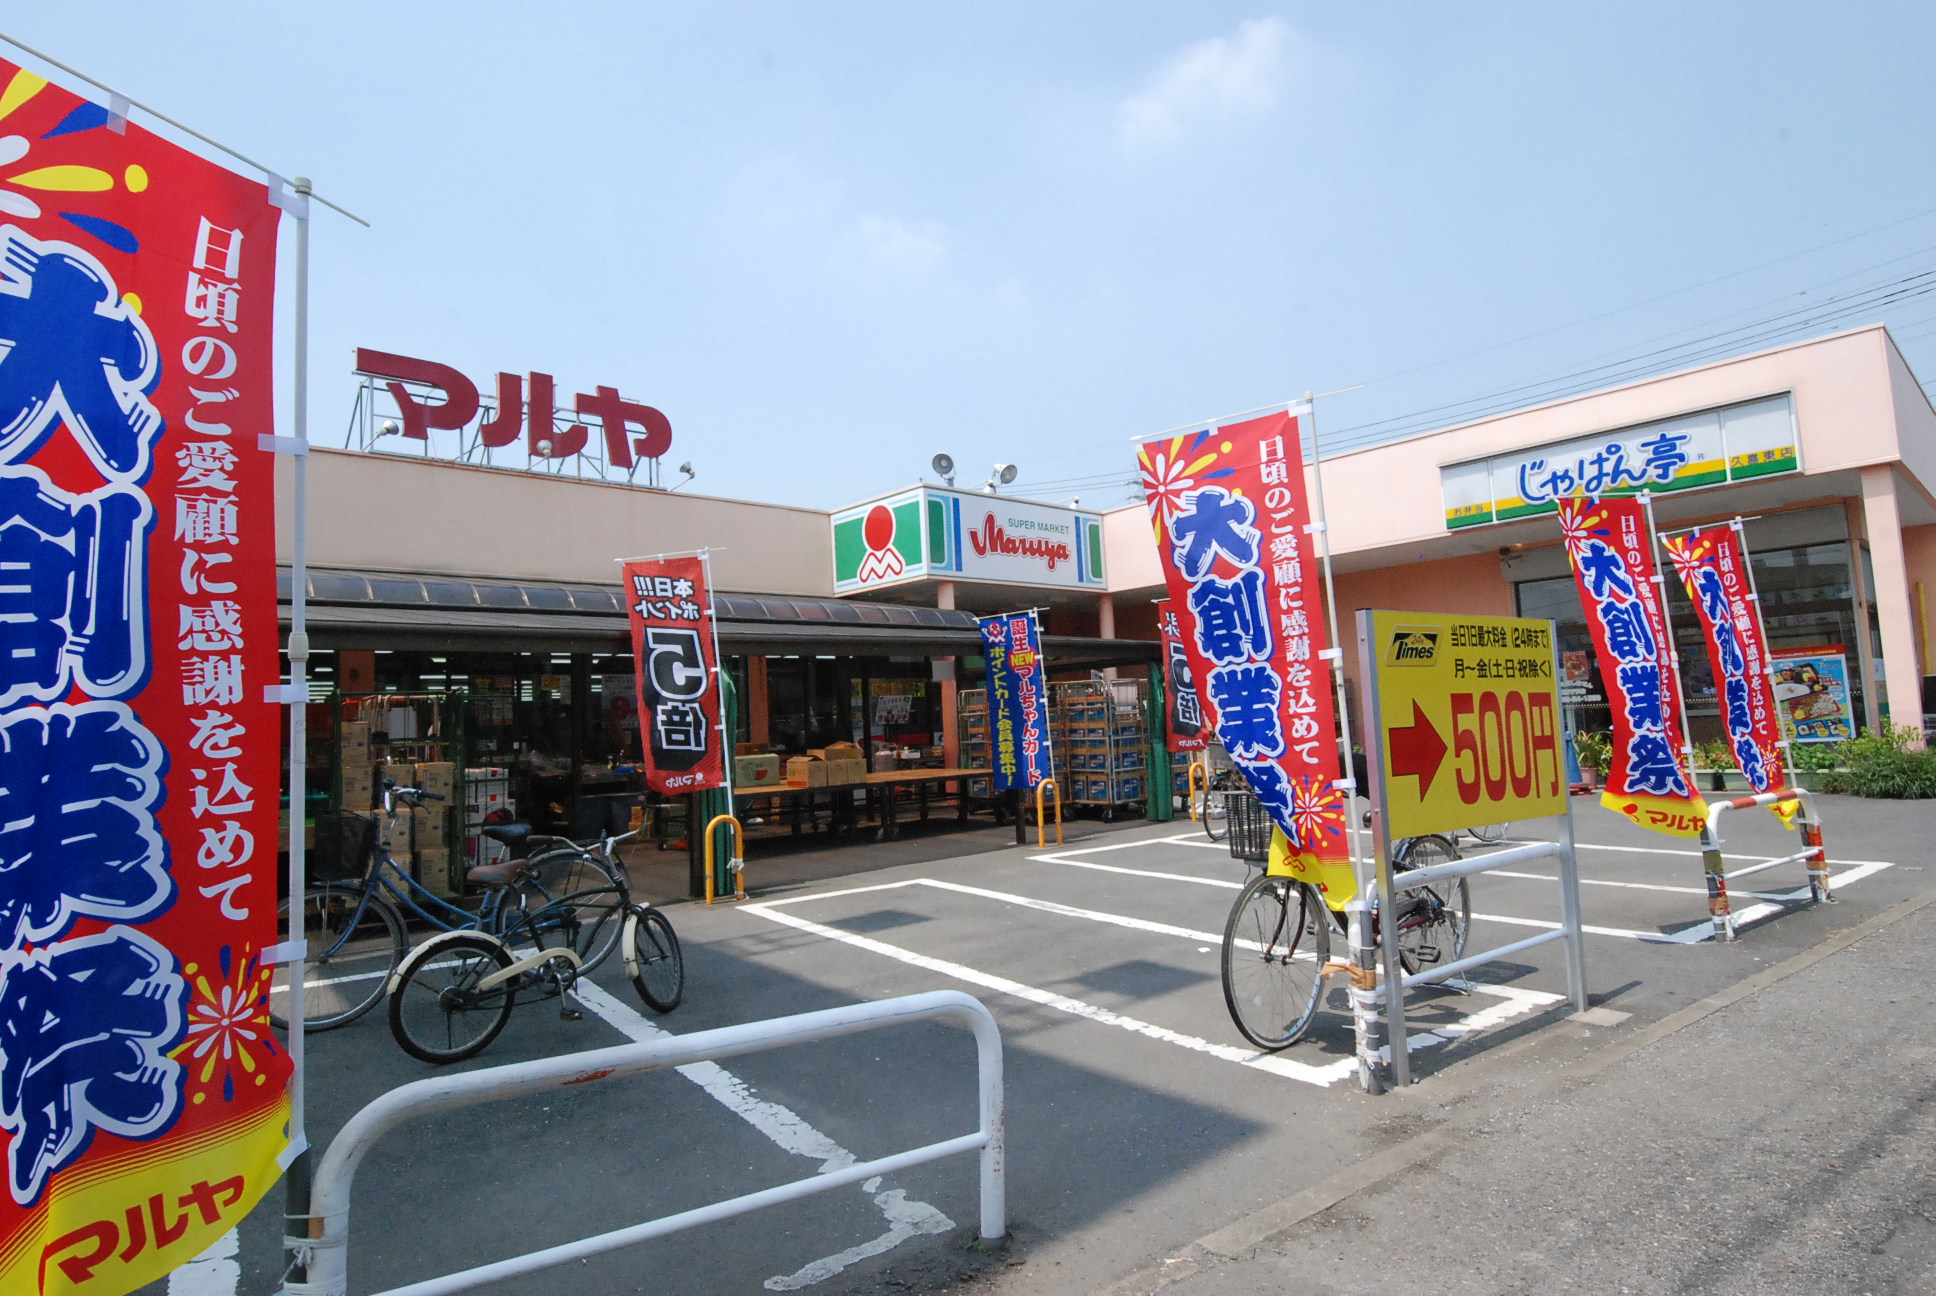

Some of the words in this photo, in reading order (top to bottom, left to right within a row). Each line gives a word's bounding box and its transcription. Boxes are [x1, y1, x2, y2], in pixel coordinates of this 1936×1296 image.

[355, 347, 672, 468] マルヤ
[1519, 432, 1689, 503] じゃぱん亭
[969, 512, 1070, 571] Maruya
[1008, 517, 1036, 529] SUPER
[1037, 521, 1070, 534] MARKET
[173, 214, 255, 921] 日頃のご愛顧に感謝を込めて
[1259, 435, 1319, 764] 日頃のご愛顧に感謝を込めて
[1010, 617, 1031, 654] 誕生
[1011, 651, 1034, 667] NEW
[1393, 633, 1436, 661] Times
[1014, 665, 1042, 787] マルちゃんカード
[1450, 690, 1559, 805] 500円
[1645, 809, 1707, 832] マルヤ
[39, 1175, 244, 1294] マルヤ
